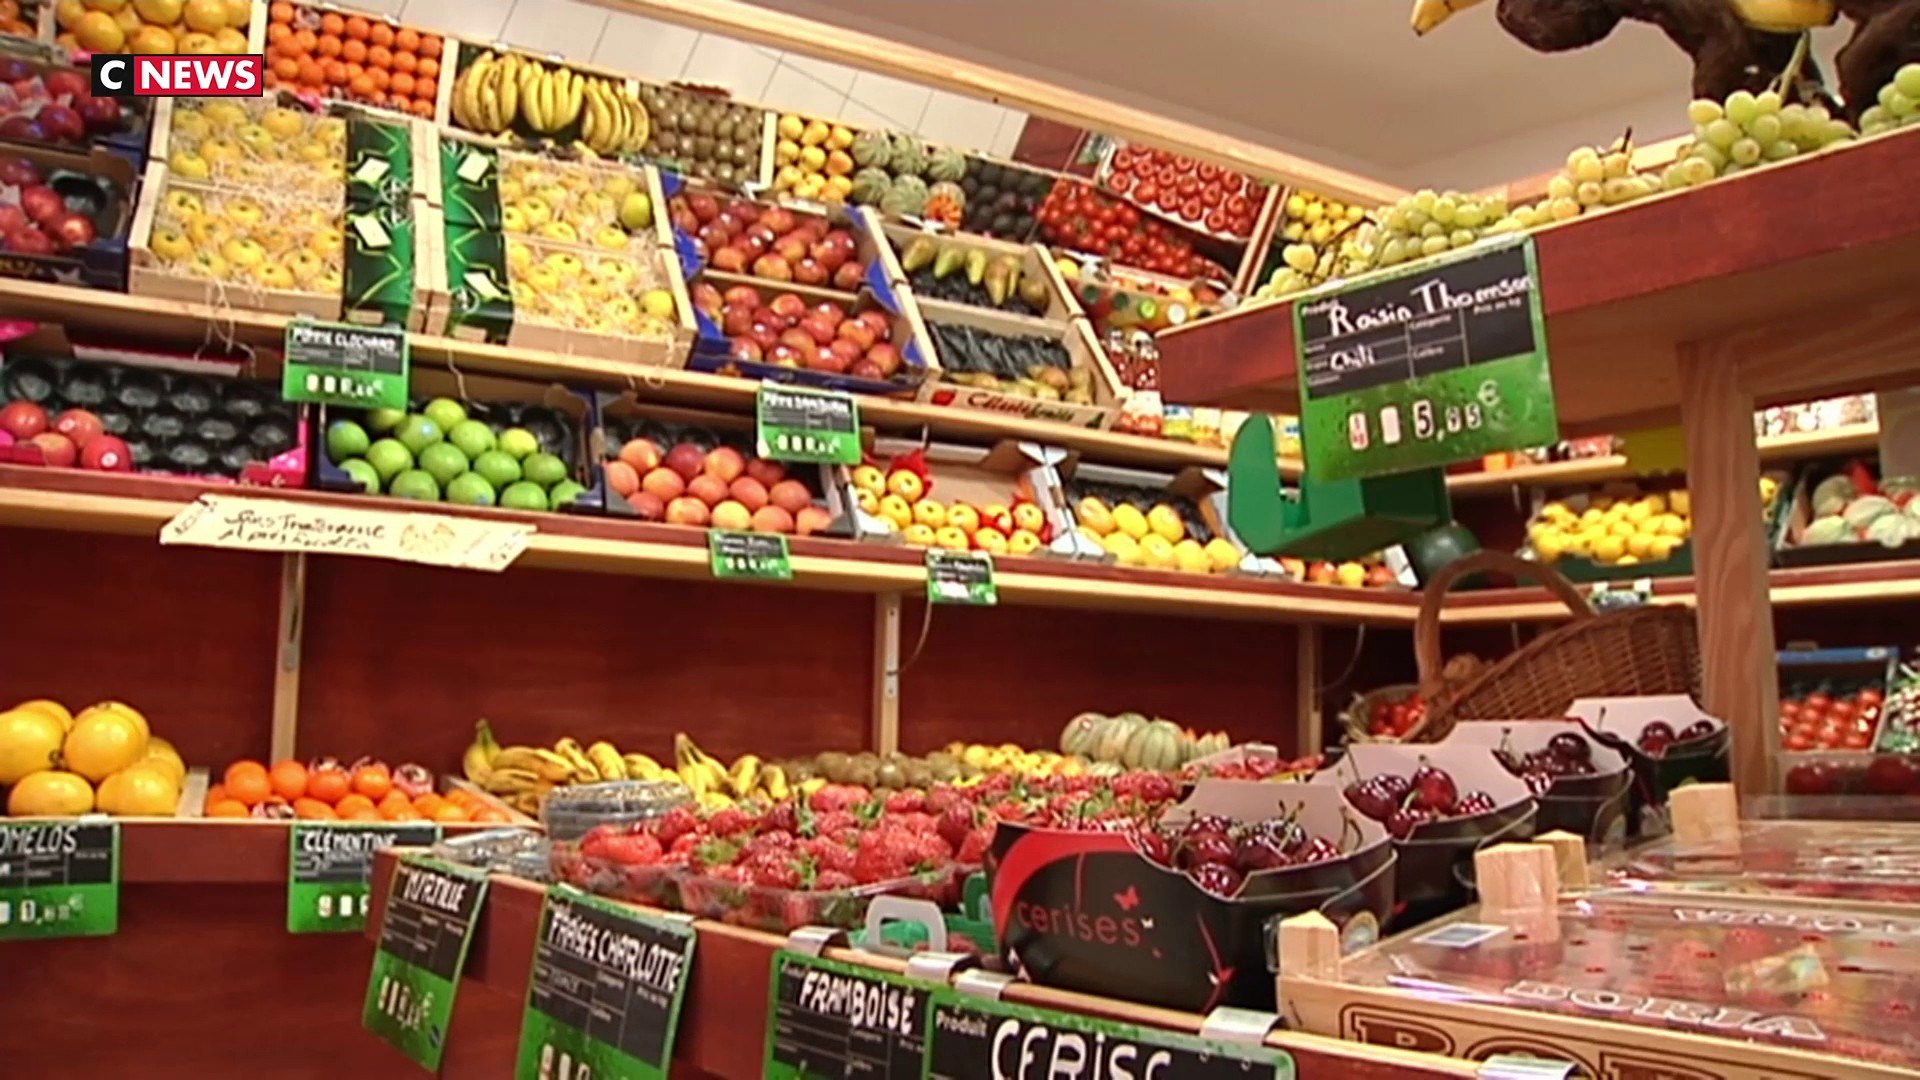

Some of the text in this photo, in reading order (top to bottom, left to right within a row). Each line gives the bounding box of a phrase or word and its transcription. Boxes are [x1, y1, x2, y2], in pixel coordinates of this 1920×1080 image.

[1329, 276, 1535, 337] Raisin Thomson
[1330, 343, 1375, 372] Chili
[1016, 901, 1141, 946] cerises
[599, 929, 684, 994] CHARLOTTE
[935, 1008, 987, 1038] Produit
